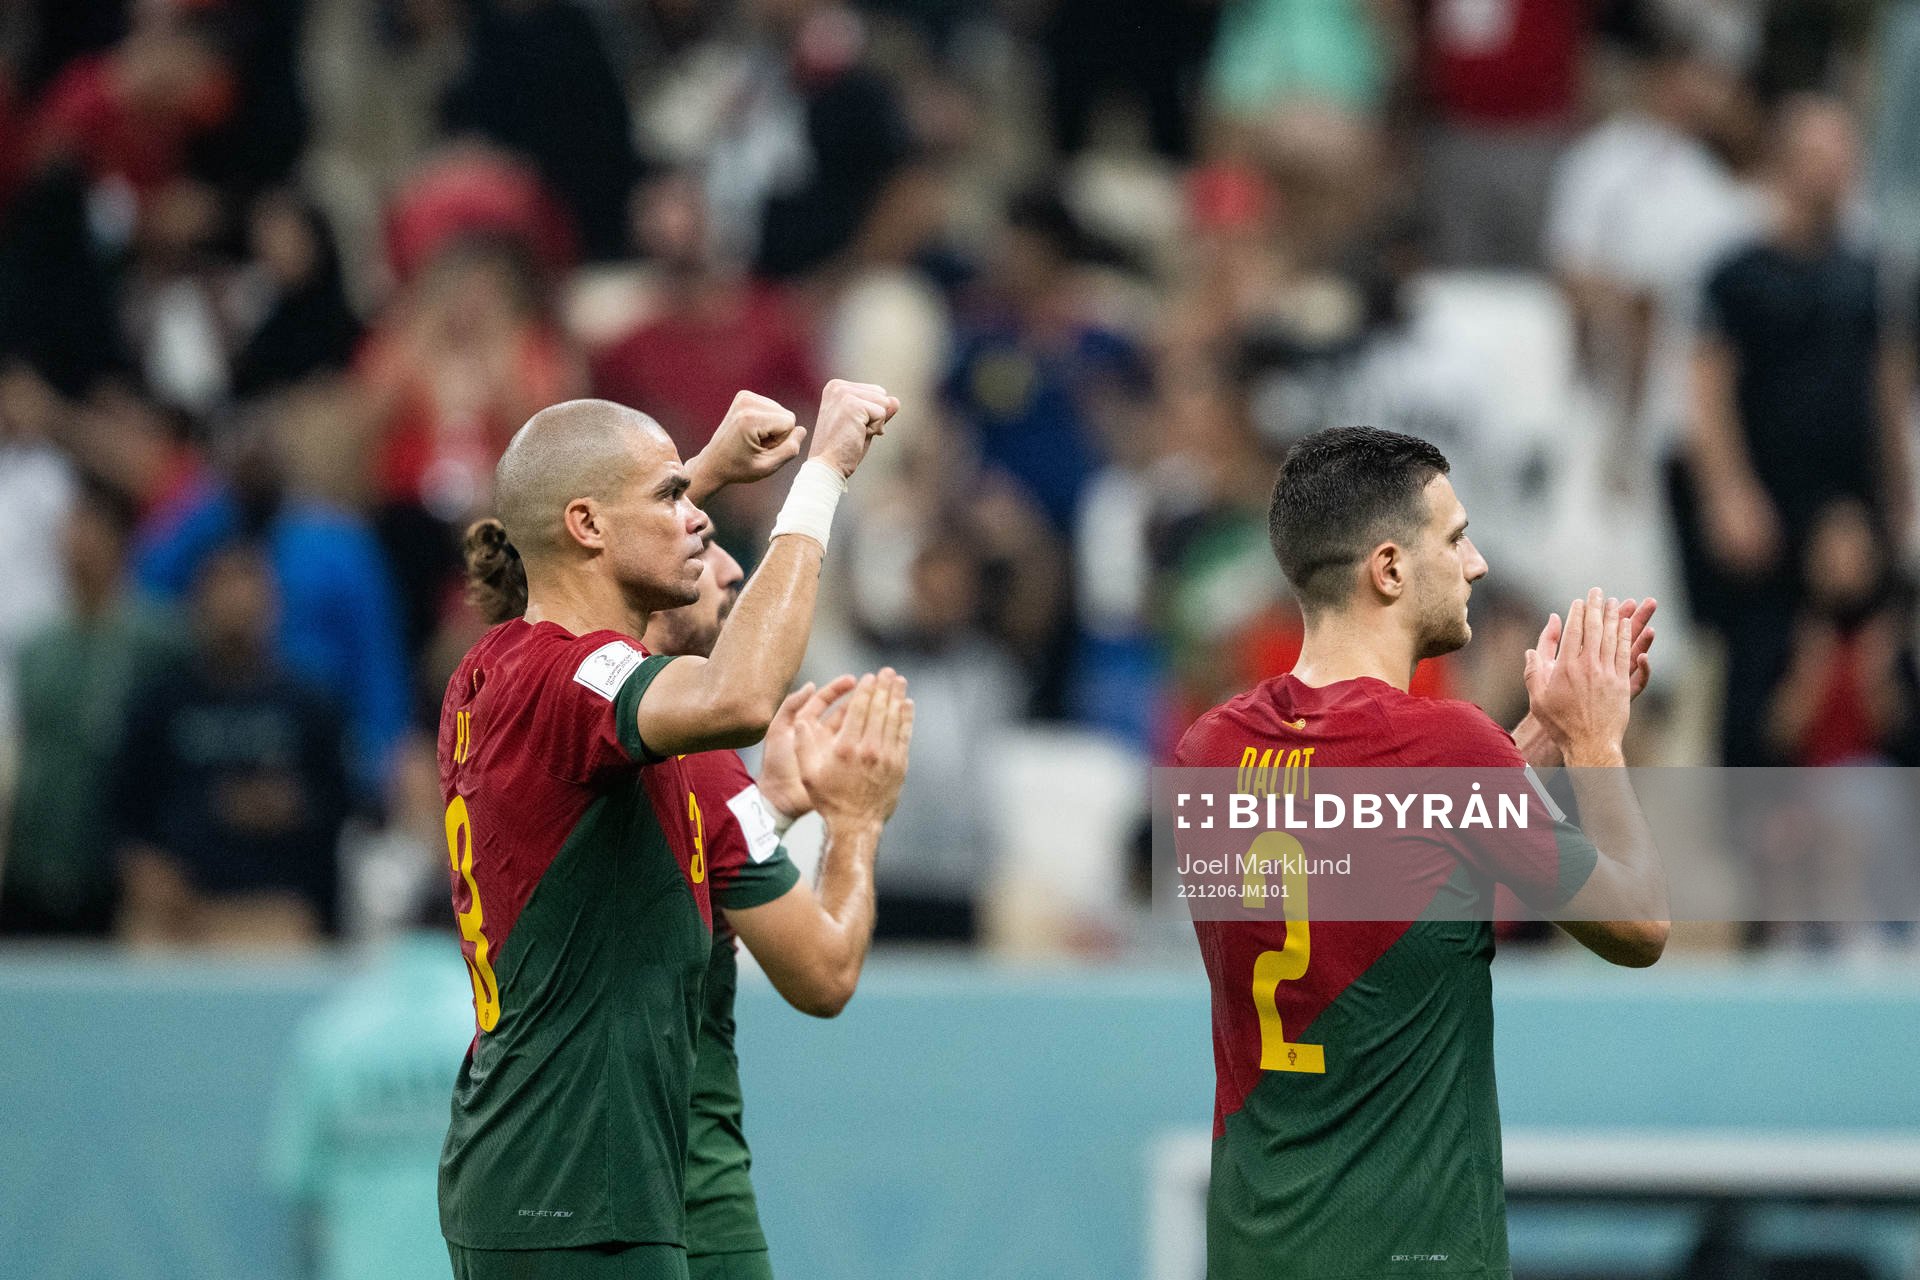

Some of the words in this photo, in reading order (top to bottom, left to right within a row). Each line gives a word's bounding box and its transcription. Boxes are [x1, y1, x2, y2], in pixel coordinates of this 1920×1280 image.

[688, 791, 705, 884] 3
[1237, 746, 1316, 800] DALOT
[445, 795, 500, 1032] 3
[1242, 831, 1326, 1074] 2
